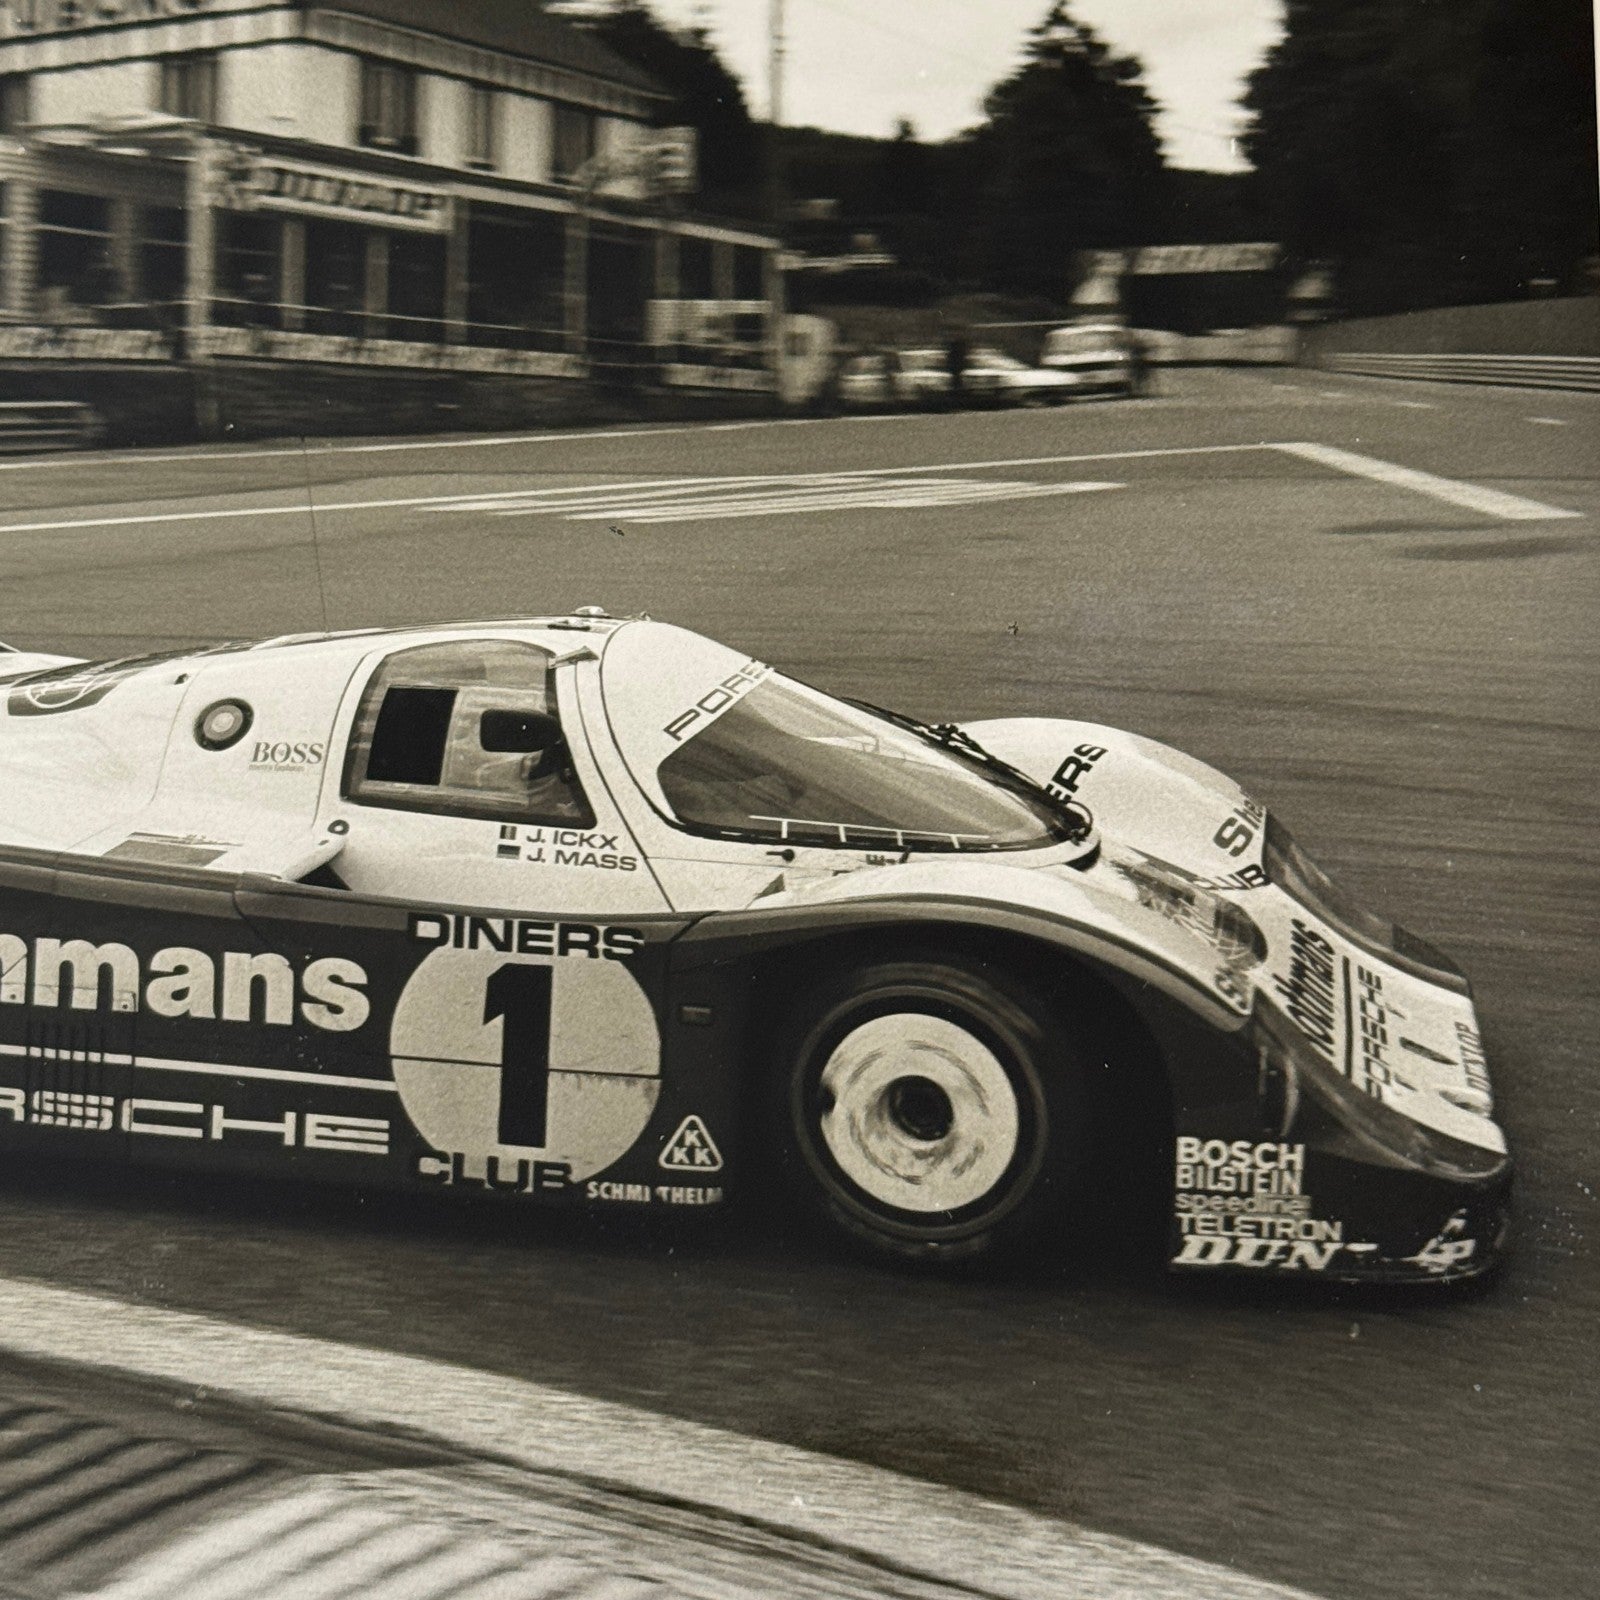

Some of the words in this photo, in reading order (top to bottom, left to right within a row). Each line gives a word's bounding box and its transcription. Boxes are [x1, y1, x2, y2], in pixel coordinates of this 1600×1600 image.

[251, 741, 324, 764] BOSS
[526, 828, 546, 844] J.
[553, 830, 619, 850] ICKX
[527, 848, 547, 863] J.
[555, 850, 637, 871] MASS
[407, 912, 644, 961] DINERS
[1272, 918, 1336, 1057] othmans
[483, 962, 553, 1148] 1
[1176, 1136, 1306, 1170] BOSCH
[411, 1150, 572, 1191] CLUB
[1176, 1163, 1303, 1195] BILSTEIN
[1175, 1212, 1343, 1241] TELETRON
